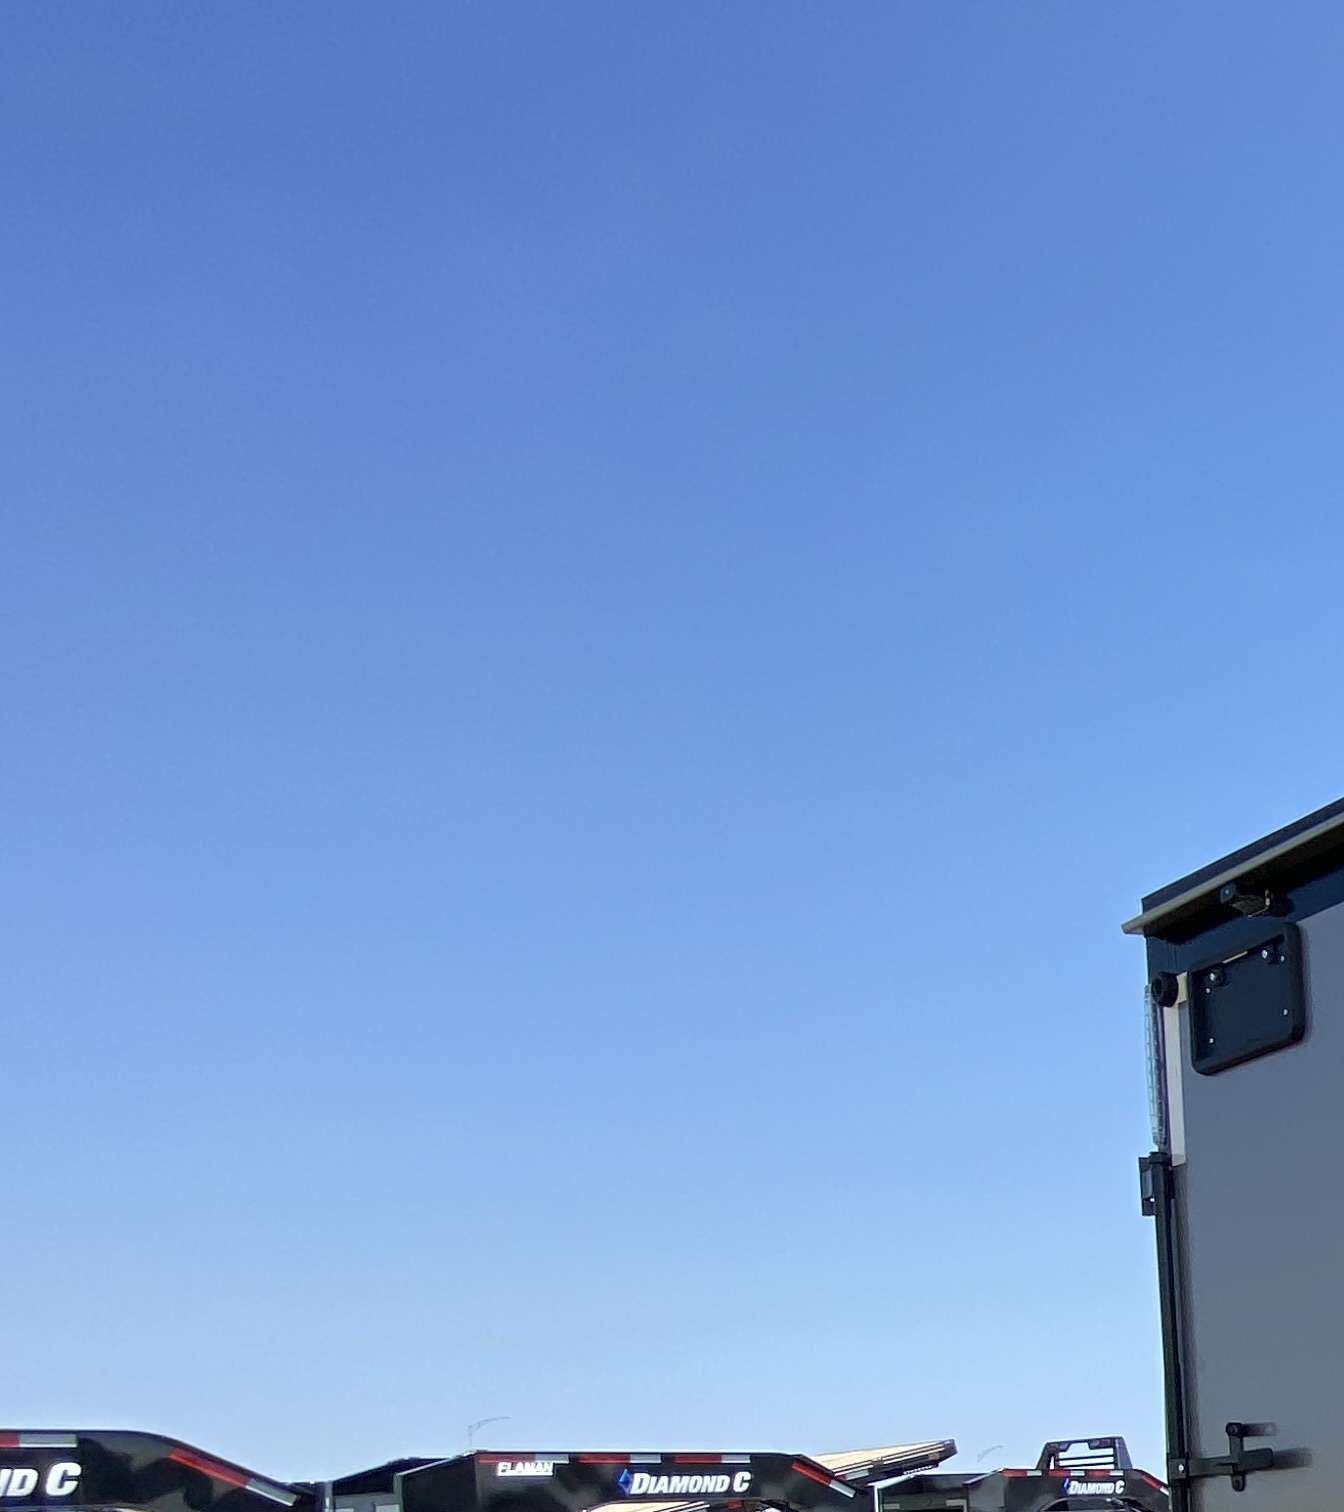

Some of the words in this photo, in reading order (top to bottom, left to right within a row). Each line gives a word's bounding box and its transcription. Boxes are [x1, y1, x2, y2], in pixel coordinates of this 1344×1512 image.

[45, 1462, 82, 1496] C
[629, 1472, 731, 1495] DIAMOND
[733, 1471, 752, 1493] C
[1068, 1480, 1115, 1495] DIAMOND
[1115, 1480, 1125, 1494] C
